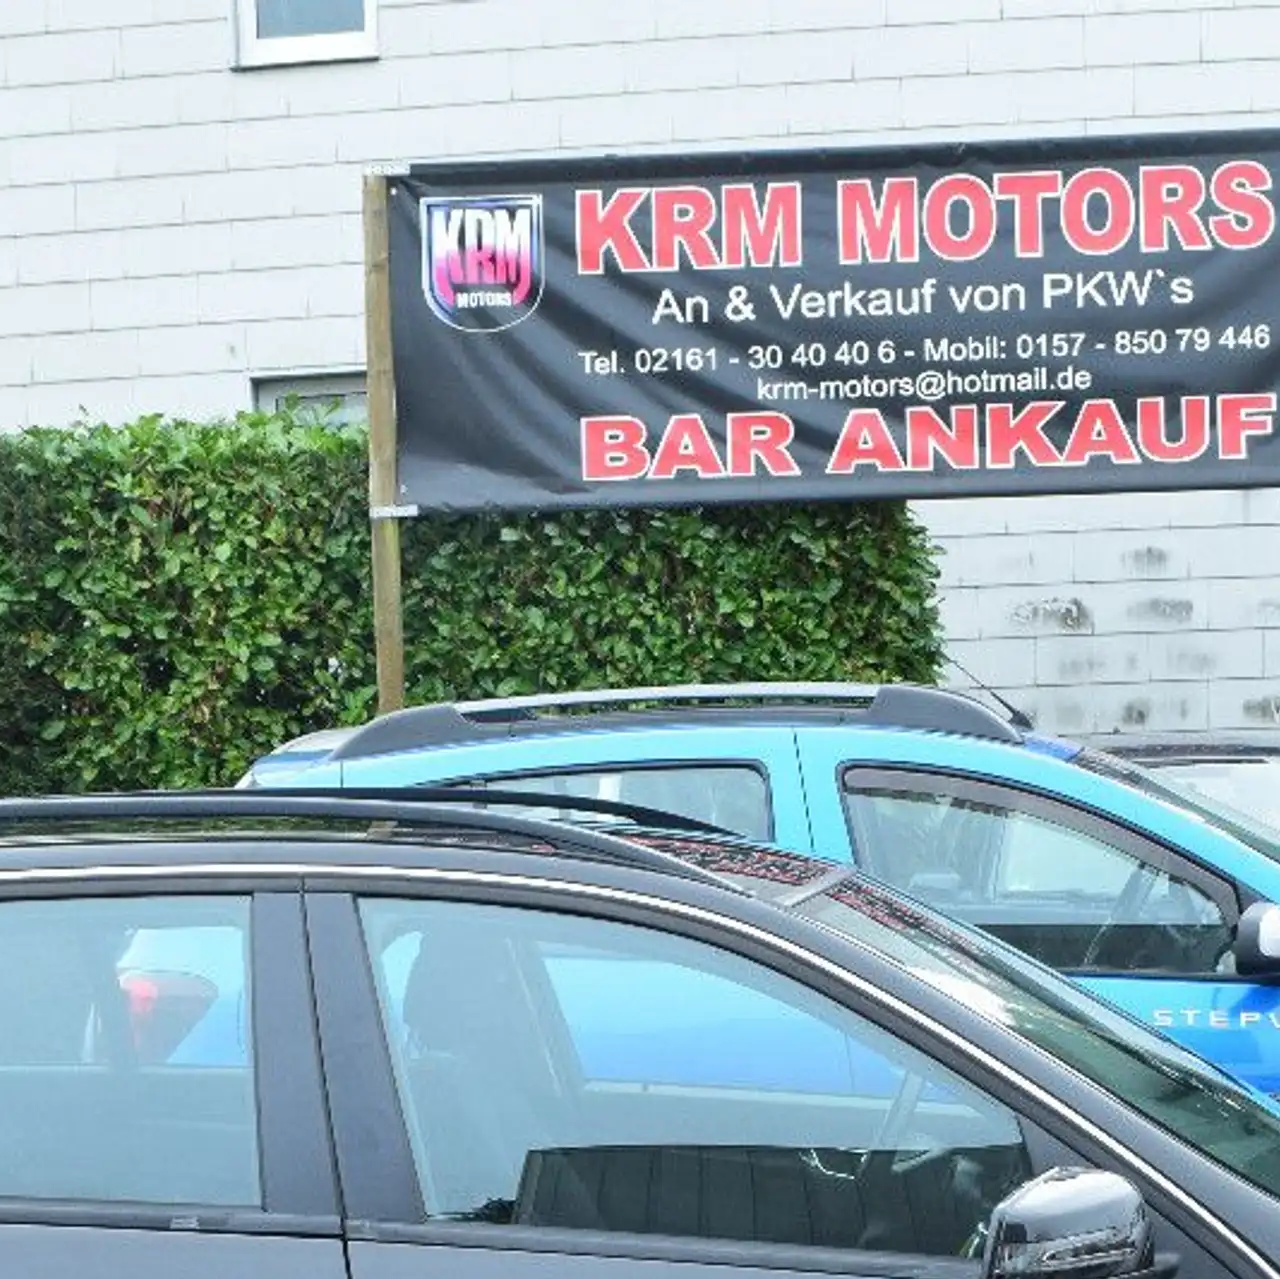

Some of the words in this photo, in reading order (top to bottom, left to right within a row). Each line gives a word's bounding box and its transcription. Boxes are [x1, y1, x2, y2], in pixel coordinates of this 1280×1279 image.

[431, 207, 533, 286] KRM
[575, 180, 802, 275] KRM
[837, 160, 1276, 265] MOTORS
[652, 288, 709, 325] An
[724, 285, 756, 323] &
[769, 277, 937, 321] Verkauf
[948, 281, 1025, 316] von
[578, 350, 625, 375] Tel.
[634, 347, 717, 374] 02161
[747, 345, 783, 369] 30
[791, 343, 826, 368] 40
[834, 341, 870, 366] 40
[877, 340, 897, 364] 6
[923, 336, 1007, 362] Mobil:
[1015, 333, 1086, 359] 0157
[1114, 329, 1168, 355] 850
[1175, 327, 1211, 352] 79
[1218, 324, 1271, 350] 446
[756, 366, 1093, 400] krm-motors@hotmail.de
[580, 411, 802, 481] BAR
[825, 392, 1277, 474] ANKAUF
